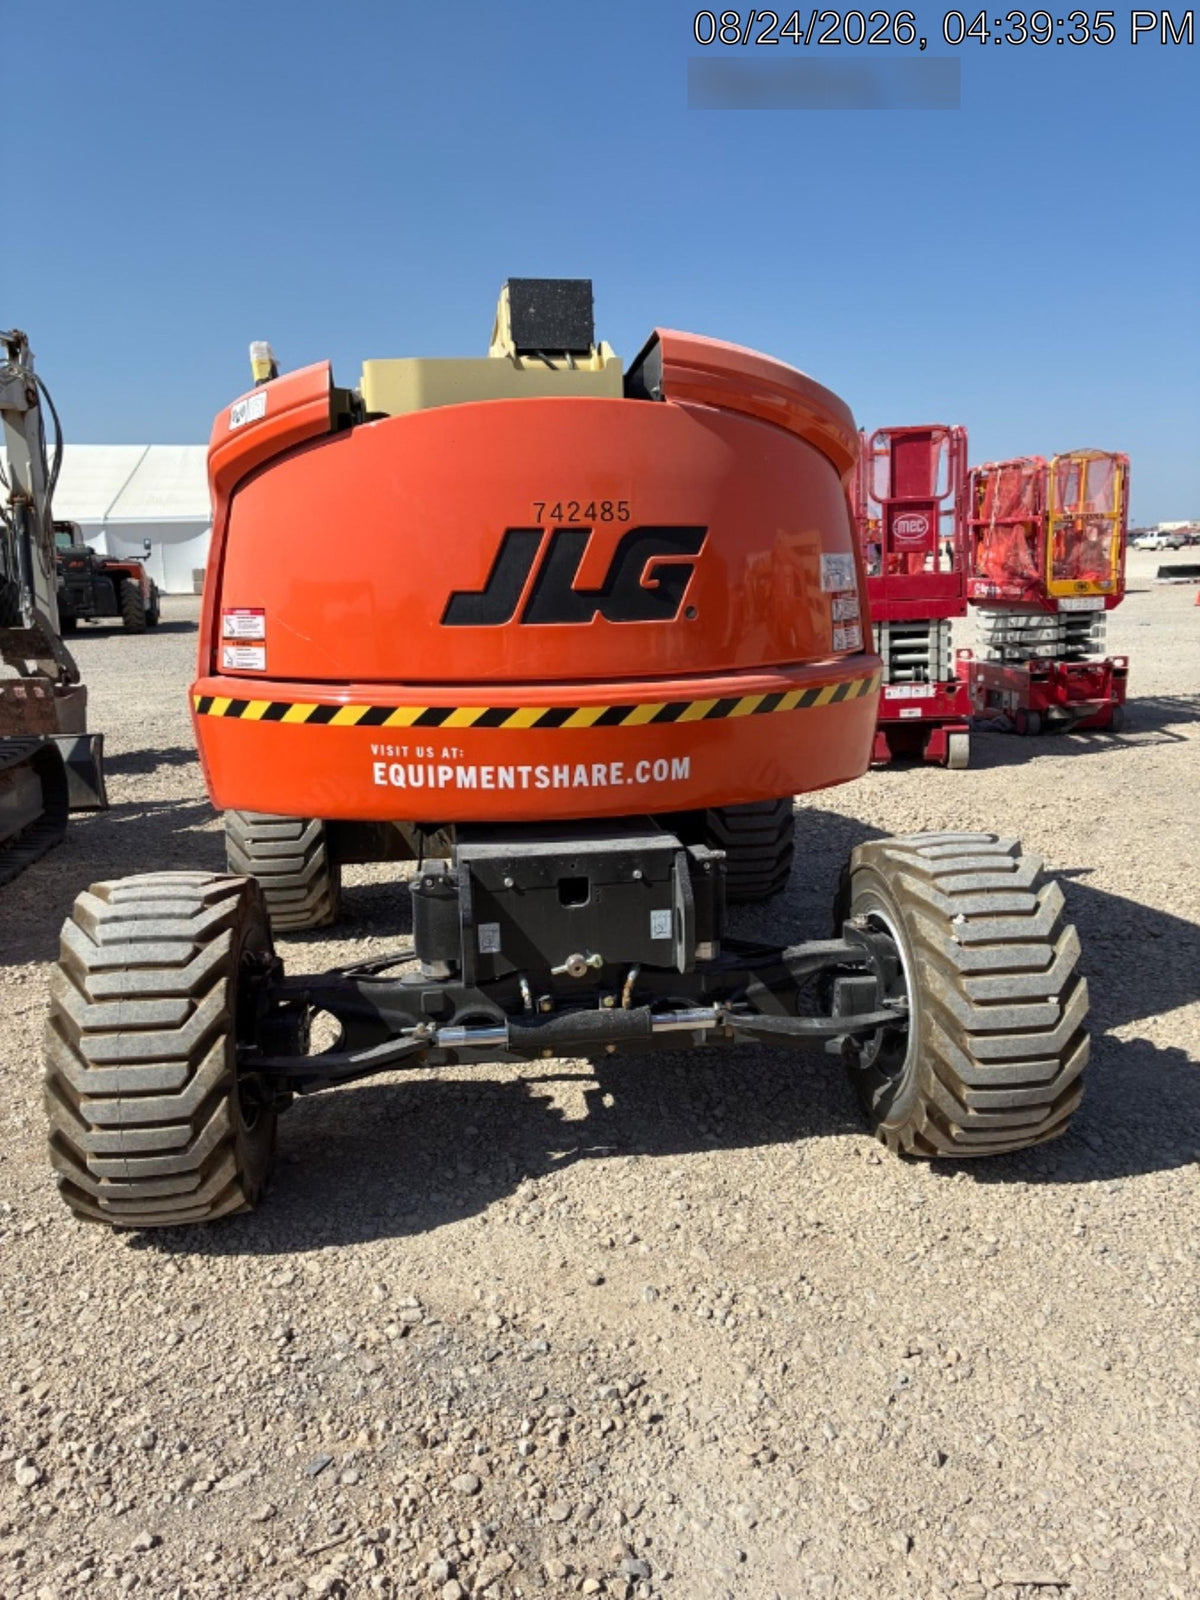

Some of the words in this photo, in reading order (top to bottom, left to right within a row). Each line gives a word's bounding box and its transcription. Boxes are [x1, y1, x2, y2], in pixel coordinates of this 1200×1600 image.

[533, 501, 631, 522] 742485
[439, 526, 709, 627] JLG
[371, 744, 409, 758] VISIT
[415, 747, 434, 758] US
[442, 747, 464, 759] AT:
[372, 757, 691, 789] EQUIPMENTSHARE.COM
